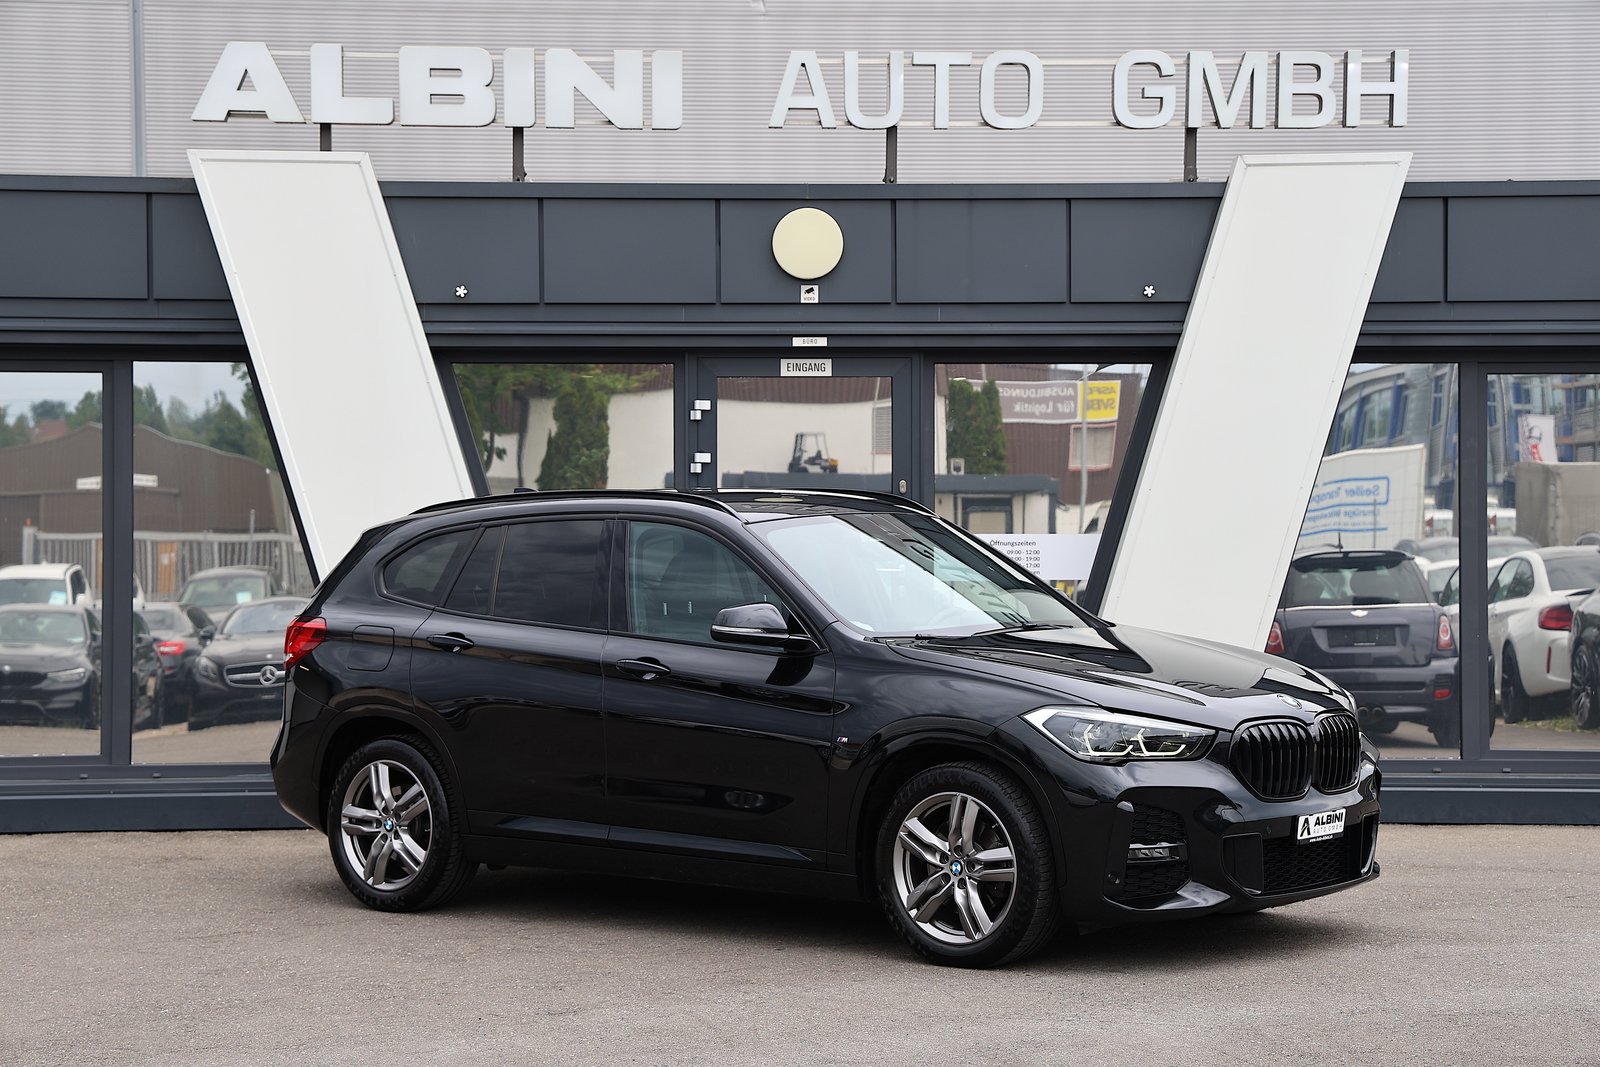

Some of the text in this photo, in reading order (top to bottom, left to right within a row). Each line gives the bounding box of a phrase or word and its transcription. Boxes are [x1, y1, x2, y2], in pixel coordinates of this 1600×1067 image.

[191, 41, 1409, 130] ALBINI AUTO GMBH
[786, 362, 826, 373] EINGANG
[989, 539, 1037, 547] Öffnungszeiten
[1314, 812, 1343, 827] ALBINI
